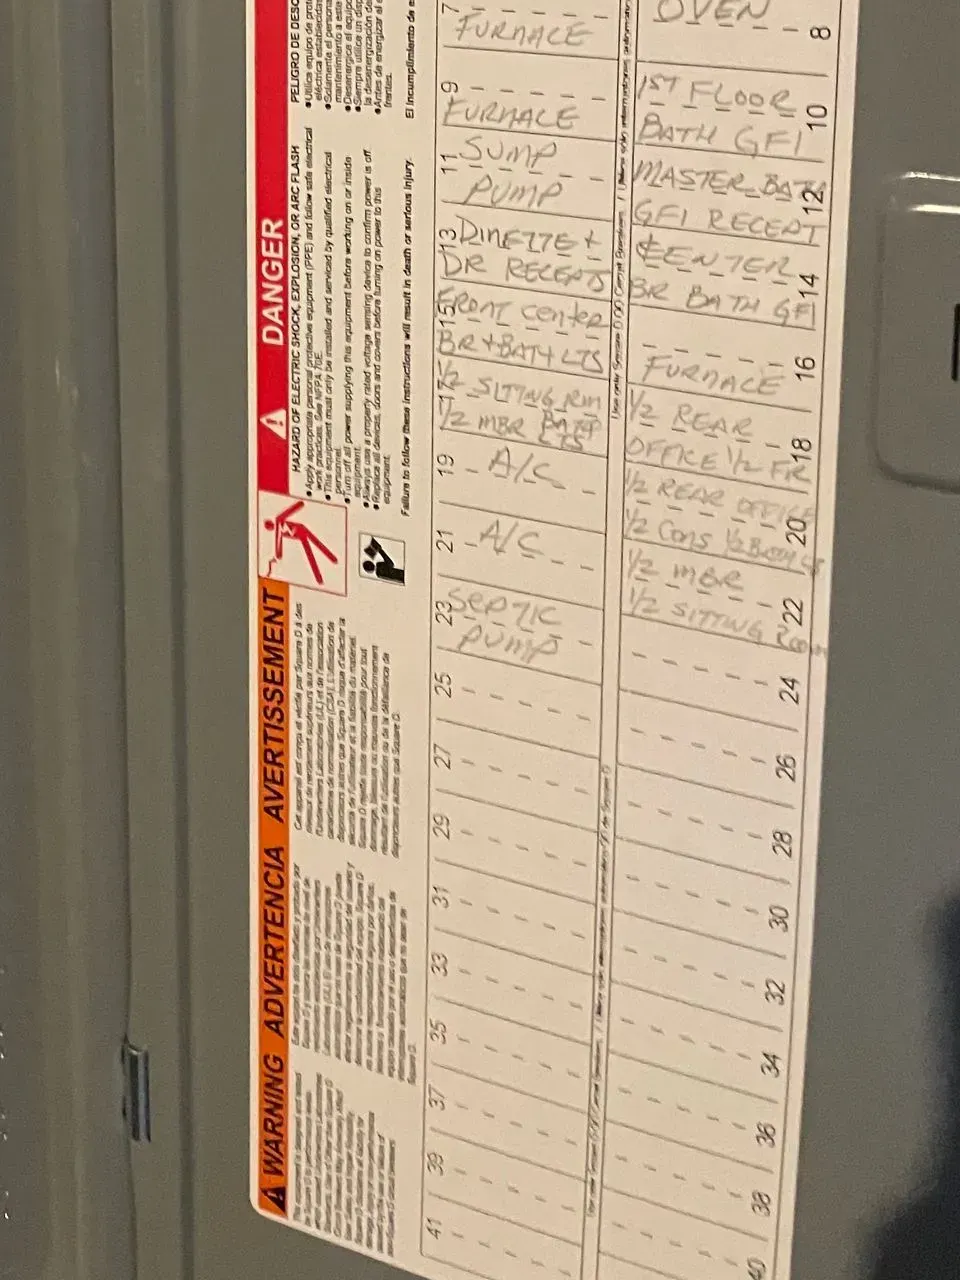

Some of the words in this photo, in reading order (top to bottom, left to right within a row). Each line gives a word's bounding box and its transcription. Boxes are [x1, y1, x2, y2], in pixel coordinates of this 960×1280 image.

[442, 3, 460, 15] 7
[290, 33, 300, 48] DE
[456, 14, 594, 48] FURNACE
[810, 26, 831, 40] 8
[290, 52, 300, 103] PELIGRO
[441, 81, 458, 94] 9
[441, 95, 580, 130] FURNACE
[688, 79, 797, 117] FLOOR
[806, 103, 828, 131] 10
[637, 113, 717, 146] BATH
[733, 127, 803, 159] GFI
[291, 145, 300, 185] FLASH
[440, 153, 458, 174] 11
[458, 136, 557, 170] SUMP
[633, 158, 744, 189] MASTER
[291, 188, 300, 210] ARC
[462, 175, 564, 208] PUMP
[802, 188, 825, 216] 12
[291, 213, 300, 229] OR
[456, 215, 578, 255] DINETTE
[633, 198, 688, 228] GFI
[708, 209, 827, 245] RECEPT
[438, 228, 457, 252] 13
[439, 250, 488, 279] DR
[262, 218, 285, 345] DANGER
[798, 272, 820, 298] 14
[628, 277, 673, 303] BR
[684, 285, 761, 317] BATH
[438, 302, 457, 328] 15
[291, 351, 300, 406] ELECTRIC
[644, 354, 786, 396] FURNACE
[794, 355, 816, 381] 16
[291, 408, 300, 423] OF
[672, 406, 753, 438] REAR
[292, 427, 301, 472] HAZARD
[624, 436, 720, 473] OFFICE
[792, 437, 813, 464] 18
[436, 455, 456, 478] 19
[487, 446, 565, 489] A/C
[435, 529, 455, 553] 21
[478, 520, 546, 557] A/C
[786, 518, 807, 547] 20
[435, 600, 455, 626] 23
[782, 596, 804, 626] 22
[456, 624, 560, 663] PUMP
[435, 673, 453, 698] 25
[779, 675, 801, 705] 24
[262, 587, 286, 823] AVERTISSEMENT
[434, 743, 451, 769] 27
[774, 753, 797, 784] 26
[433, 813, 451, 838] 29
[771, 830, 793, 860] 28
[432, 885, 449, 908] 31
[768, 905, 789, 932] 30
[263, 846, 285, 1037] ADVERTENCIA
[430, 952, 448, 977] 33
[764, 977, 786, 1005] 32
[761, 1051, 782, 1077] 34
[263, 1054, 284, 1177] WARNING
